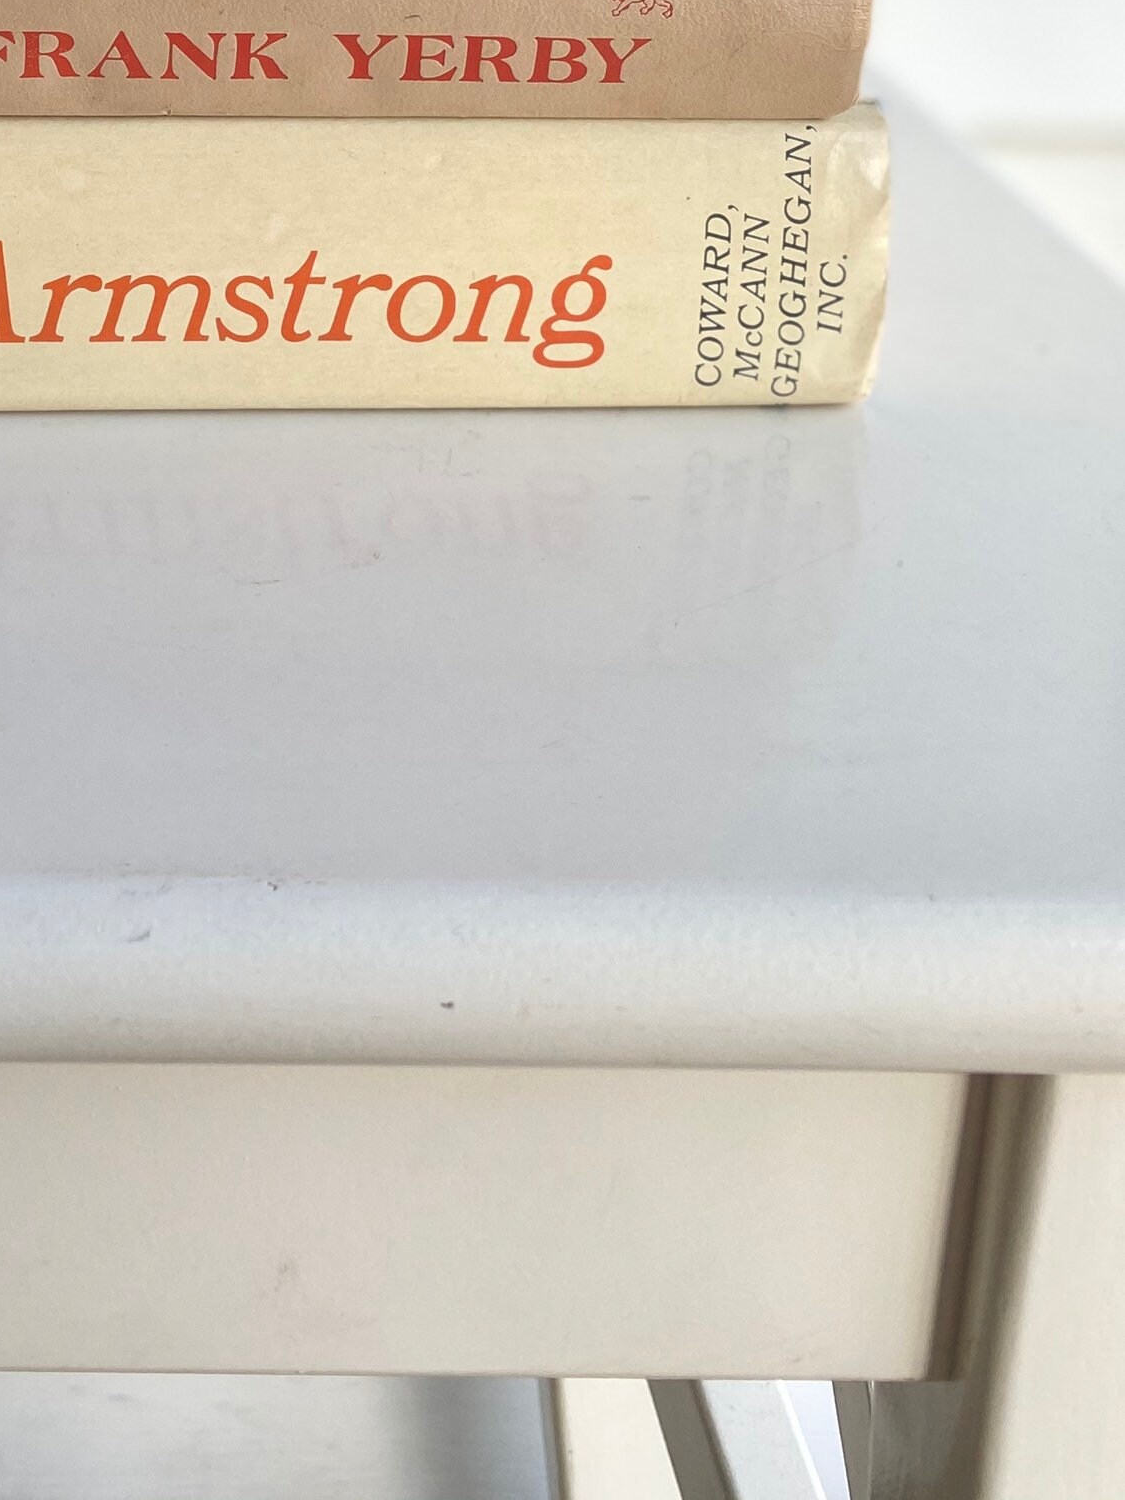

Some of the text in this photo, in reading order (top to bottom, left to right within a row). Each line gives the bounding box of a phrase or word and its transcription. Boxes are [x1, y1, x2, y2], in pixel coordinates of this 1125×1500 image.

[333, 33, 652, 85] YERBY
[694, 204, 740, 387] COWARD,
[733, 212, 771, 382] McCANN
[770, 124, 818, 398] GEOGHEGAN,
[816, 254, 849, 334] INC.
